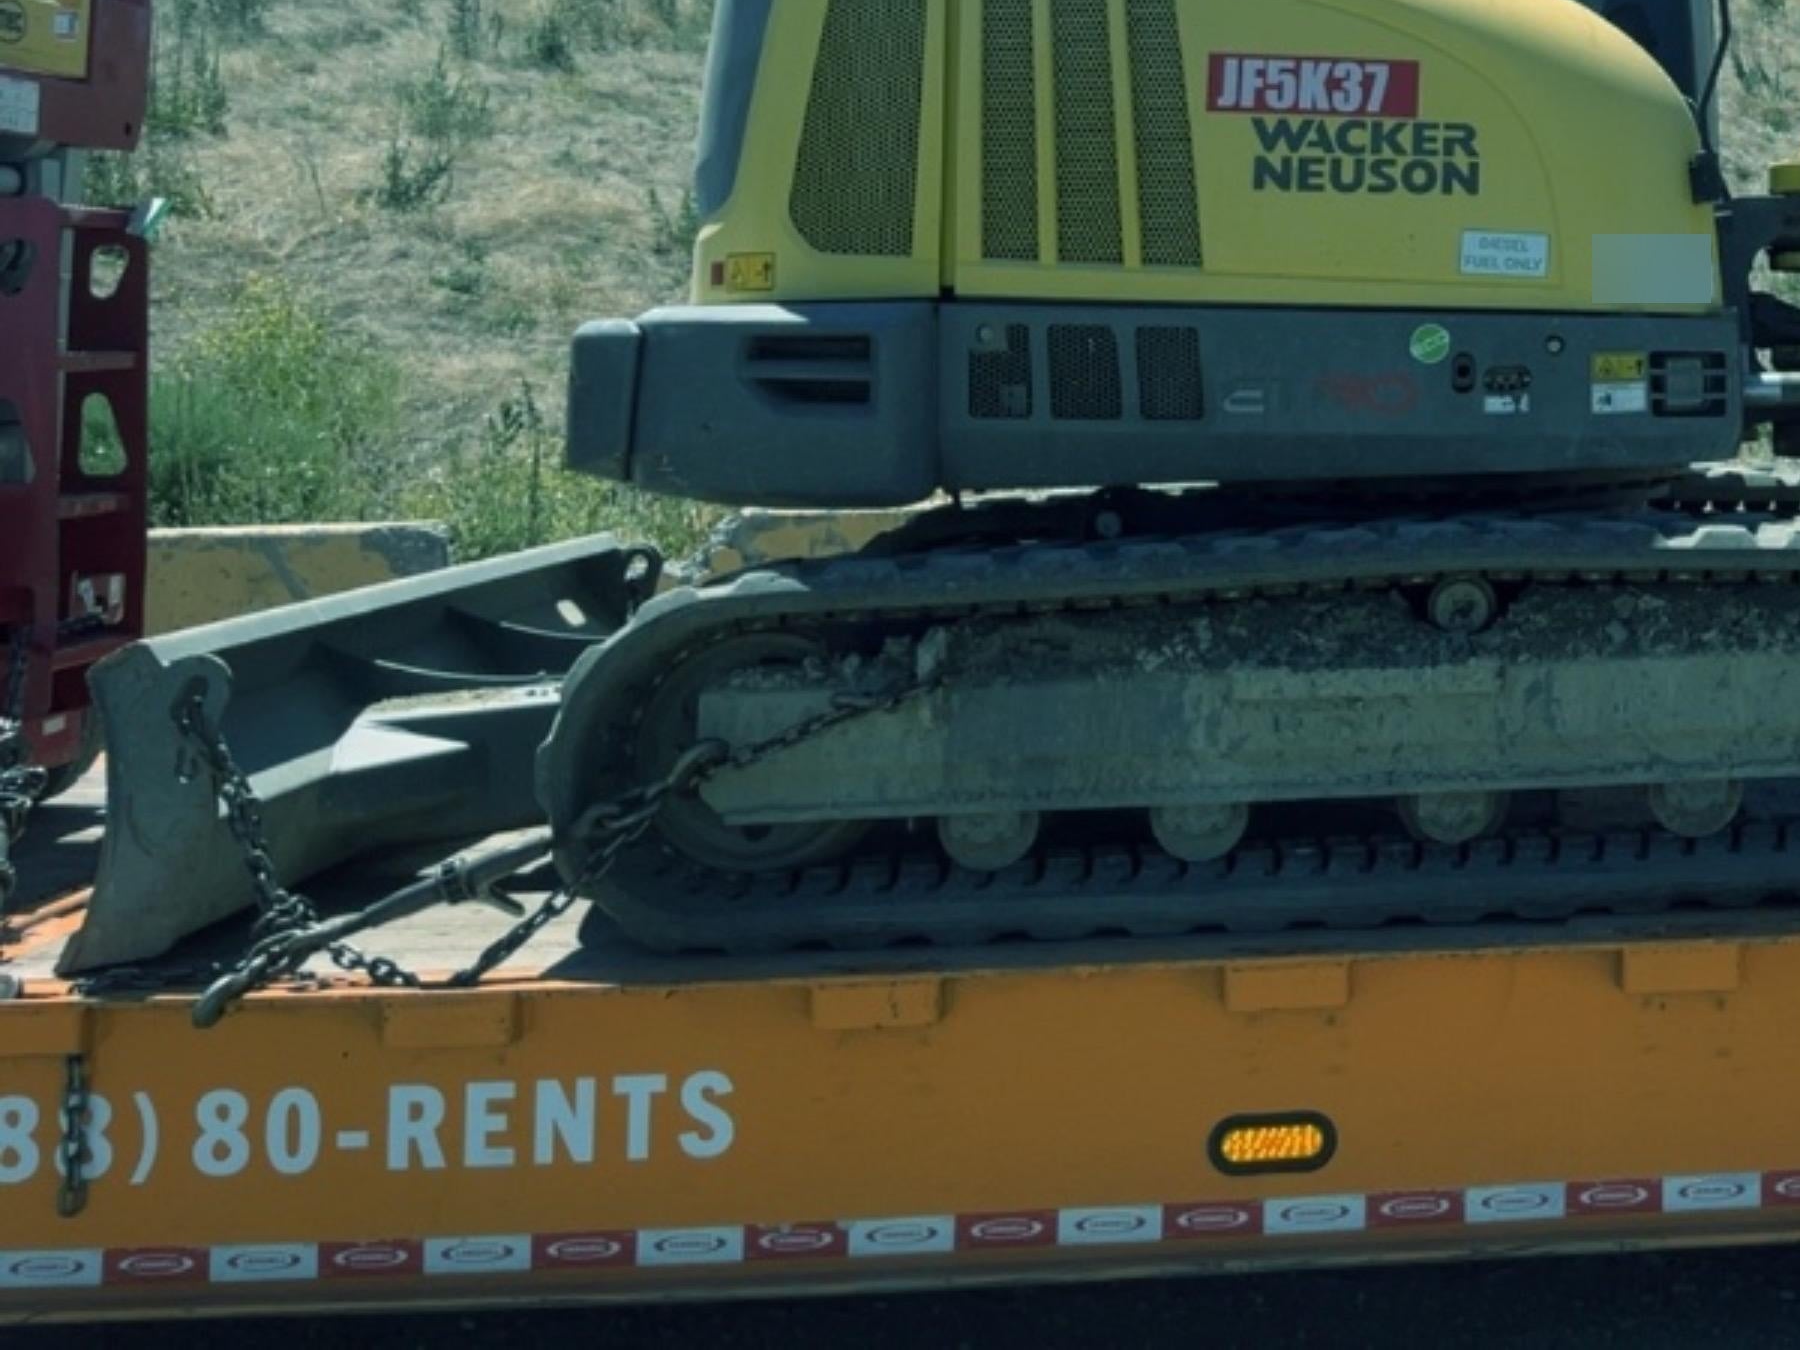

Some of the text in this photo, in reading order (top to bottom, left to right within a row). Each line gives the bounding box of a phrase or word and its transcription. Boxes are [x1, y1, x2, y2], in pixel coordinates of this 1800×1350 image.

[1217, 58, 1390, 114] JF5K37
[1250, 116, 1480, 156] WACKER
[1253, 156, 1480, 195] NEUSON
[1463, 254, 1543, 272] FUEL ONLY
[1478, 236, 1529, 252] DIESEL
[192, 1069, 735, 1178] 80-RENTS
